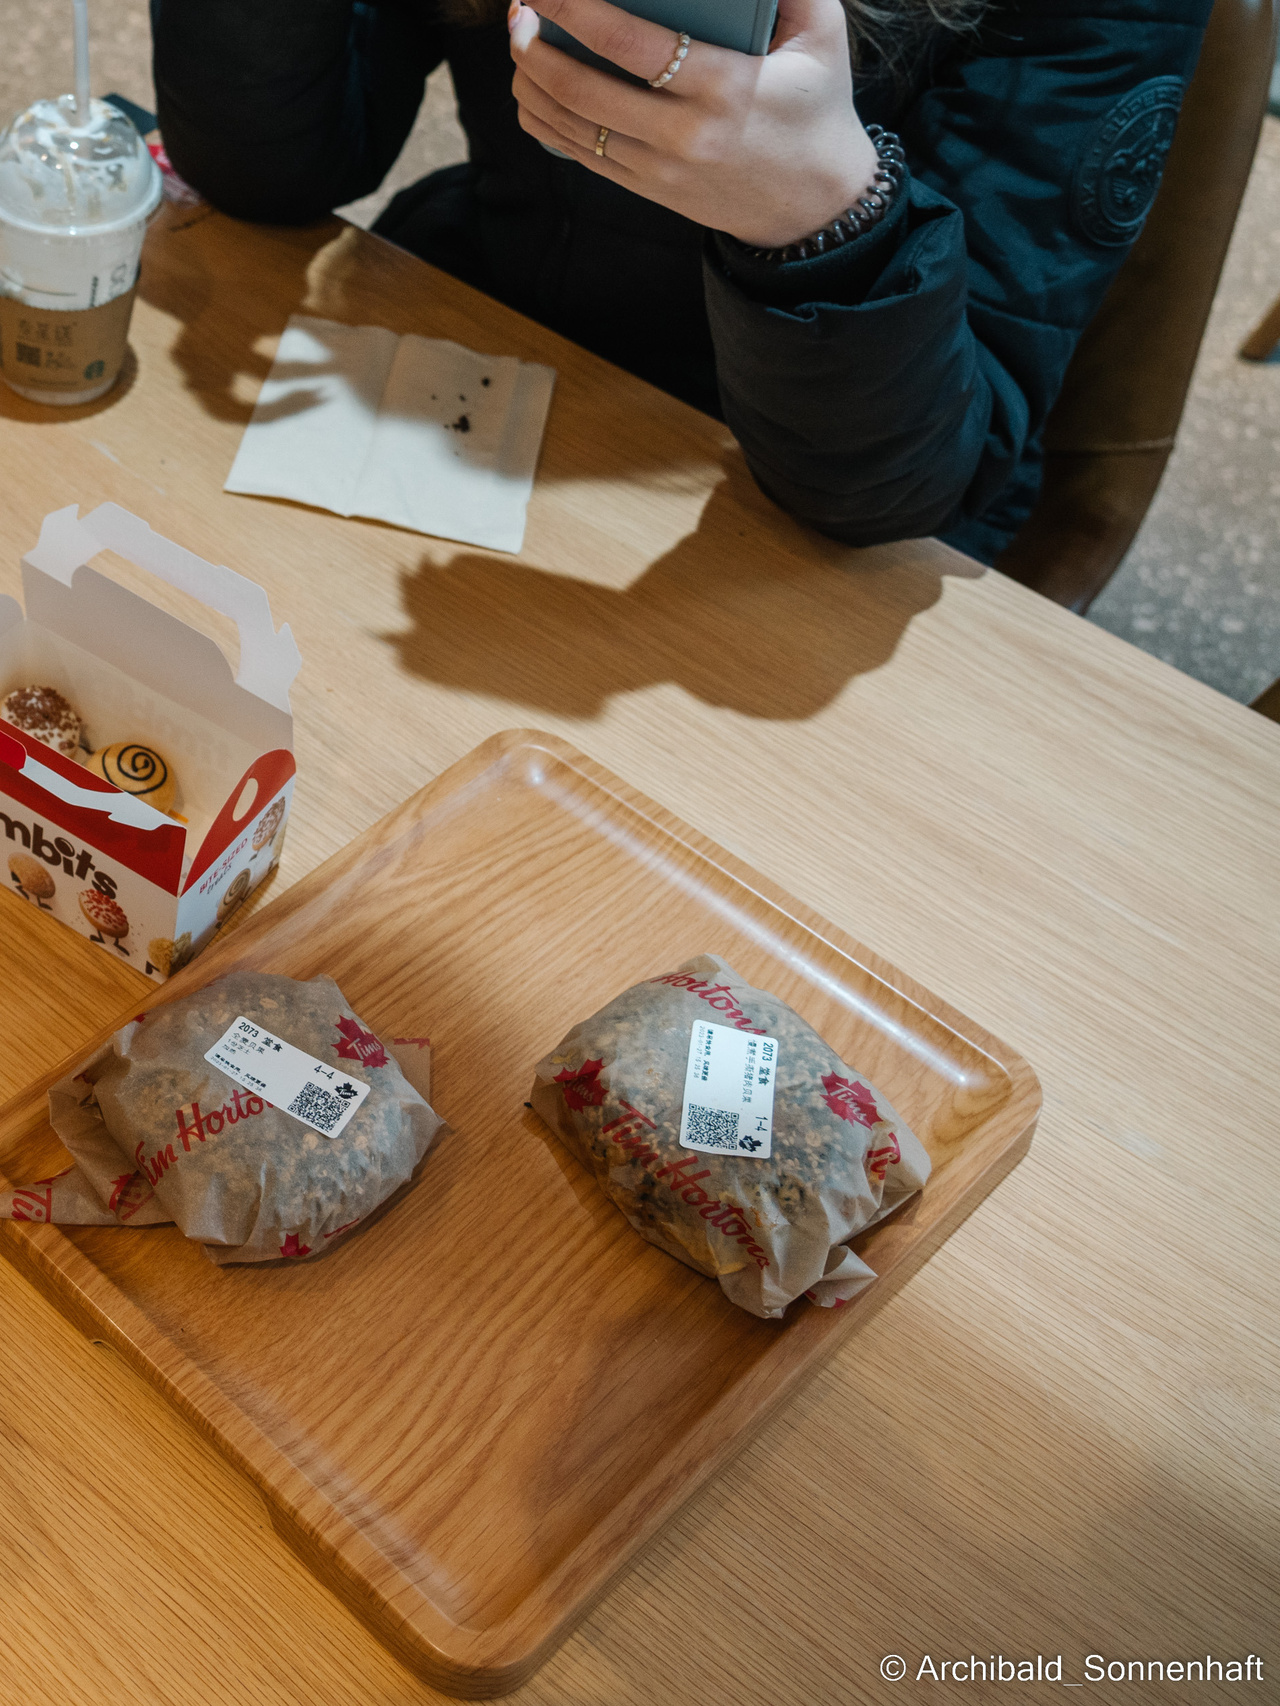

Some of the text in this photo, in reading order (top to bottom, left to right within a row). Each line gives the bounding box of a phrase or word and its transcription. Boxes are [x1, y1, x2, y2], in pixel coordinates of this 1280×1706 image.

[199, 838, 248, 894] BITE-SIZED
[238, 1021, 335, 1081] 2073 堂食 4-4
[346, 1038, 381, 1060] Tims
[755, 1042, 774, 1131] 2073 堂食 1-4
[830, 1082, 867, 1121] Tims
[602, 1099, 770, 1270] Tim Hortons
